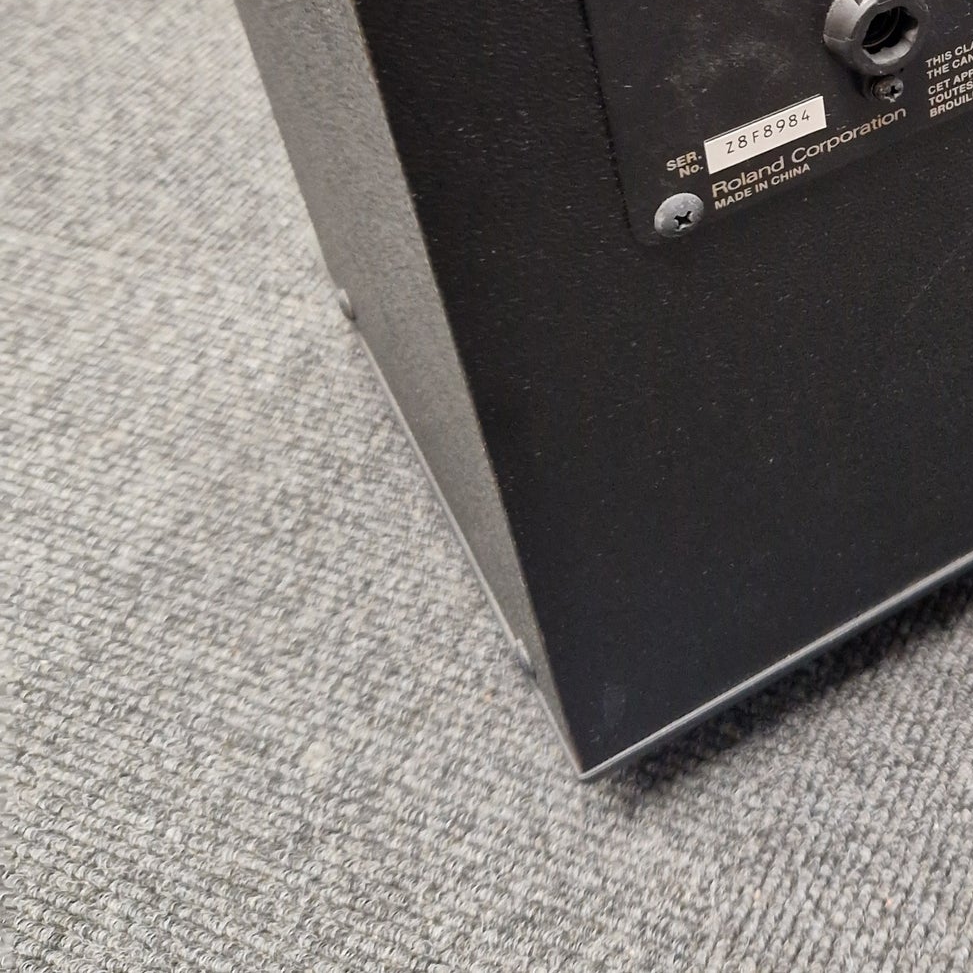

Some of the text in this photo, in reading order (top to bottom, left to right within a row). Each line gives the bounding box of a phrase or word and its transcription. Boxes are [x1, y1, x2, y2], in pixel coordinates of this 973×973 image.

[926, 50, 951, 71] THIS
[926, 62, 949, 82] THE
[927, 78, 950, 97] CET
[928, 79, 973, 109] TOUTES
[725, 107, 811, 154] Z8F8984
[666, 149, 704, 174] SER.
[711, 104, 907, 198] Roland Corporation
[679, 164, 705, 179] No.
[713, 162, 811, 211] MADE IN CHINA
